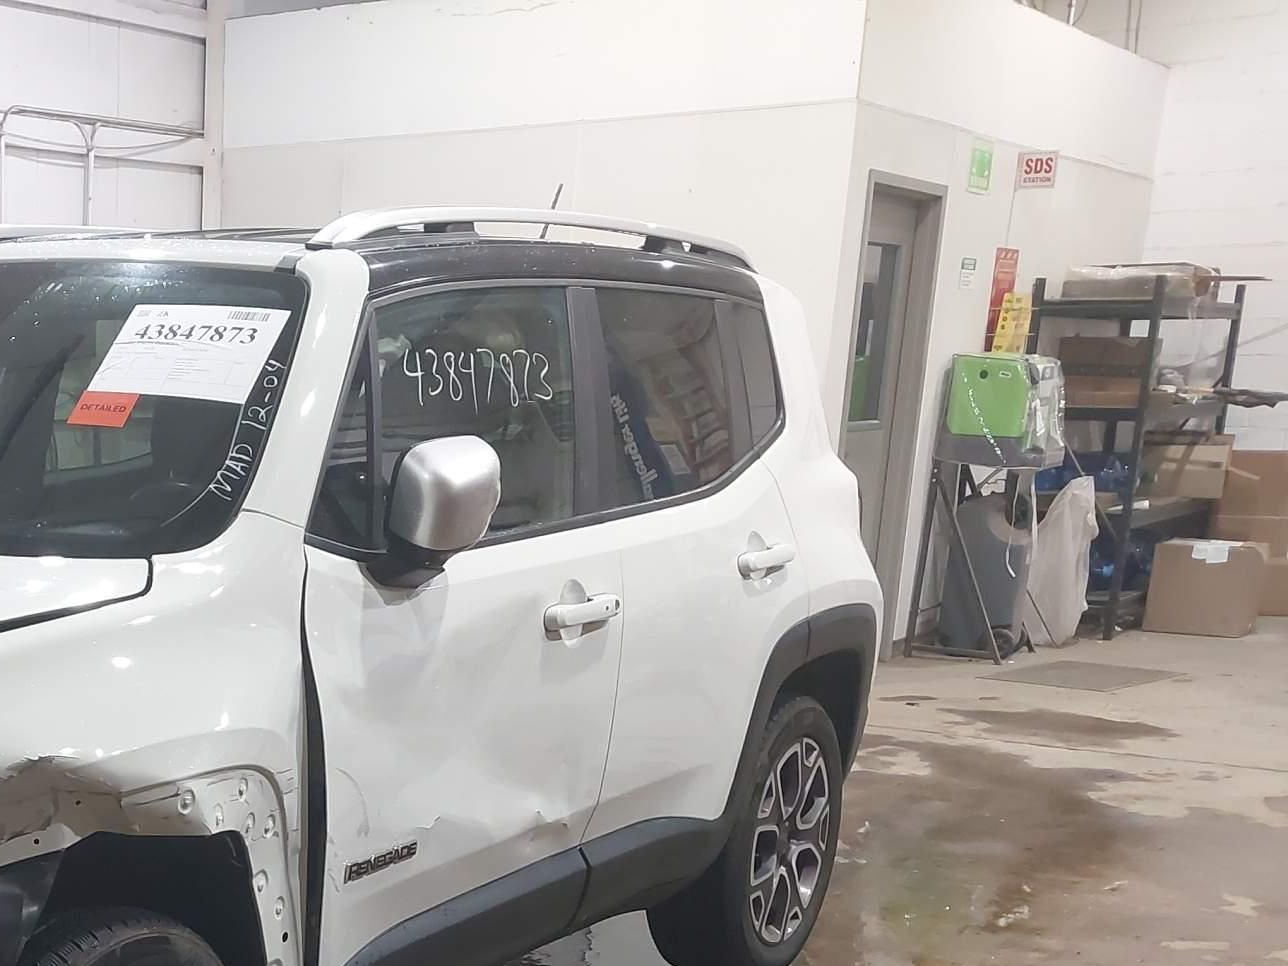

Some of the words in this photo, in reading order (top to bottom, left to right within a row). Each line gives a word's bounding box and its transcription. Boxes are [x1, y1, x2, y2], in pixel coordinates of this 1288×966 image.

[1024, 157, 1053, 175] SDS
[135, 324, 259, 345] 43847873
[403, 348, 553, 415] 43847873
[80, 403, 127, 413] DETAILED
[210, 443, 253, 501] MAD
[241, 359, 287, 431] 12-04
[343, 840, 417, 885] RENEGADE
